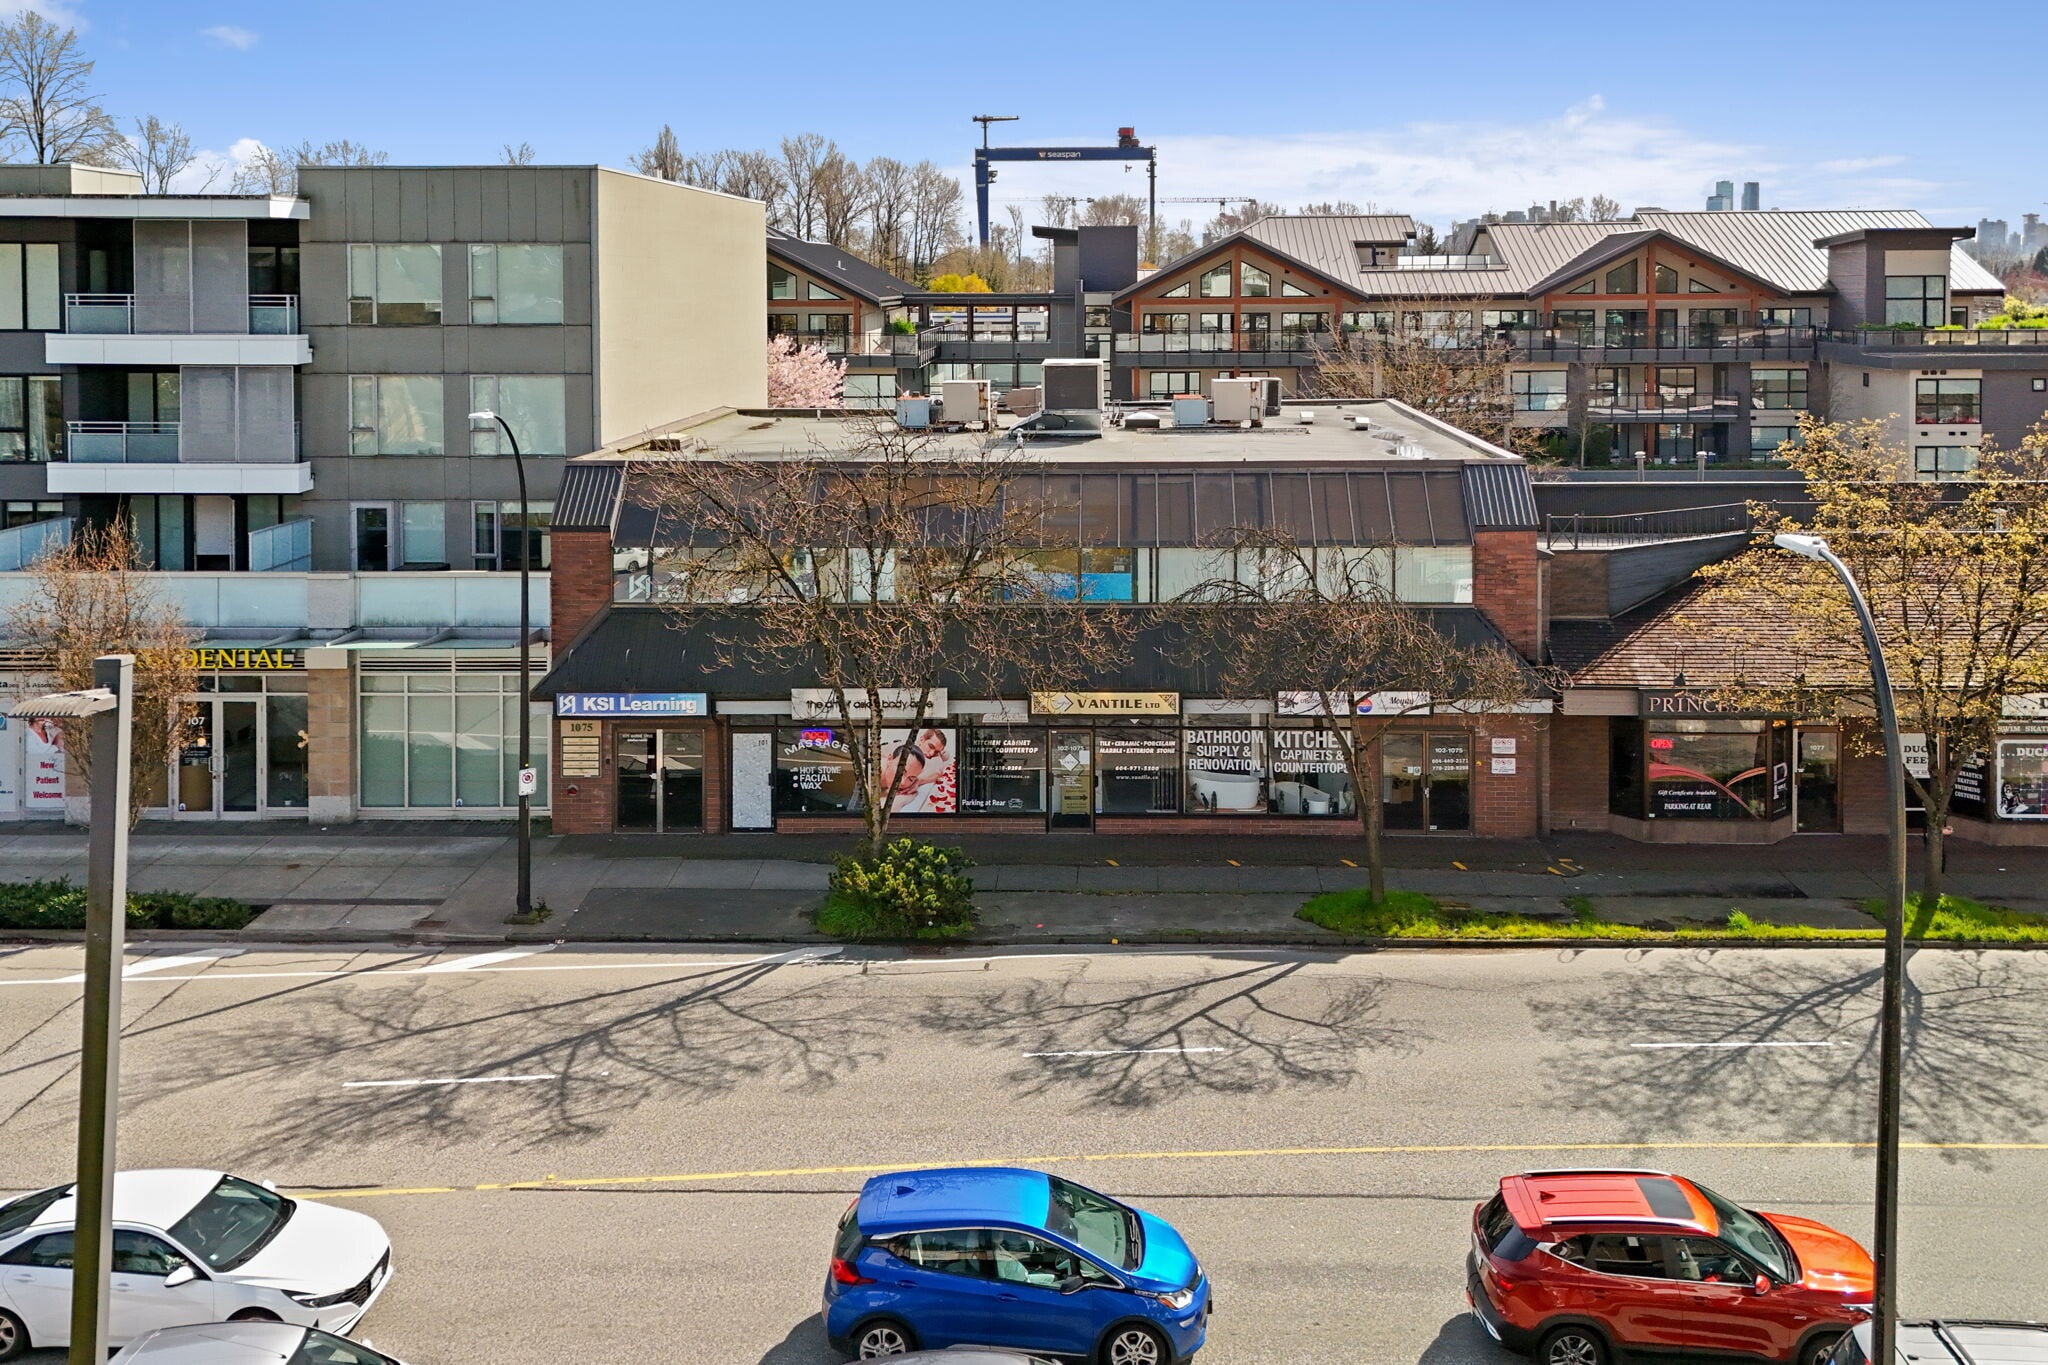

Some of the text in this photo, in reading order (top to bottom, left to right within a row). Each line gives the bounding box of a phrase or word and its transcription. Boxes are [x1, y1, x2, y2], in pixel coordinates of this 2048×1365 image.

[1047, 151, 1081, 159] seaspan
[181, 648, 293, 669] DENTAL
[583, 696, 697, 714] KSI Learning
[806, 700, 823, 709] the
[853, 700, 880, 709] asia
[882, 699, 907, 711] body
[909, 701, 933, 709] cae
[1076, 699, 1143, 709] VANTILE
[188, 716, 205, 726] 107
[571, 722, 593, 732] 1075
[1187, 730, 1264, 744] BATHROOM
[784, 737, 850, 756] MASSAGE
[1651, 738, 1673, 749] OPEN
[1196, 745, 1251, 757] SUPPLY &
[1903, 745, 1928, 753] DUC
[1336, 750, 1345, 761] &
[1906, 756, 1928, 764] FEE
[40, 761, 55, 769] New
[800, 766, 842, 774] HOT STONE
[1189, 759, 1261, 771] RENOVATION
[35, 776, 59, 784] Patient
[800, 774, 834, 782] FACIAL
[800, 782, 822, 790] WAX
[33, 791, 63, 799] Welcome
[962, 799, 984, 807] Parking
